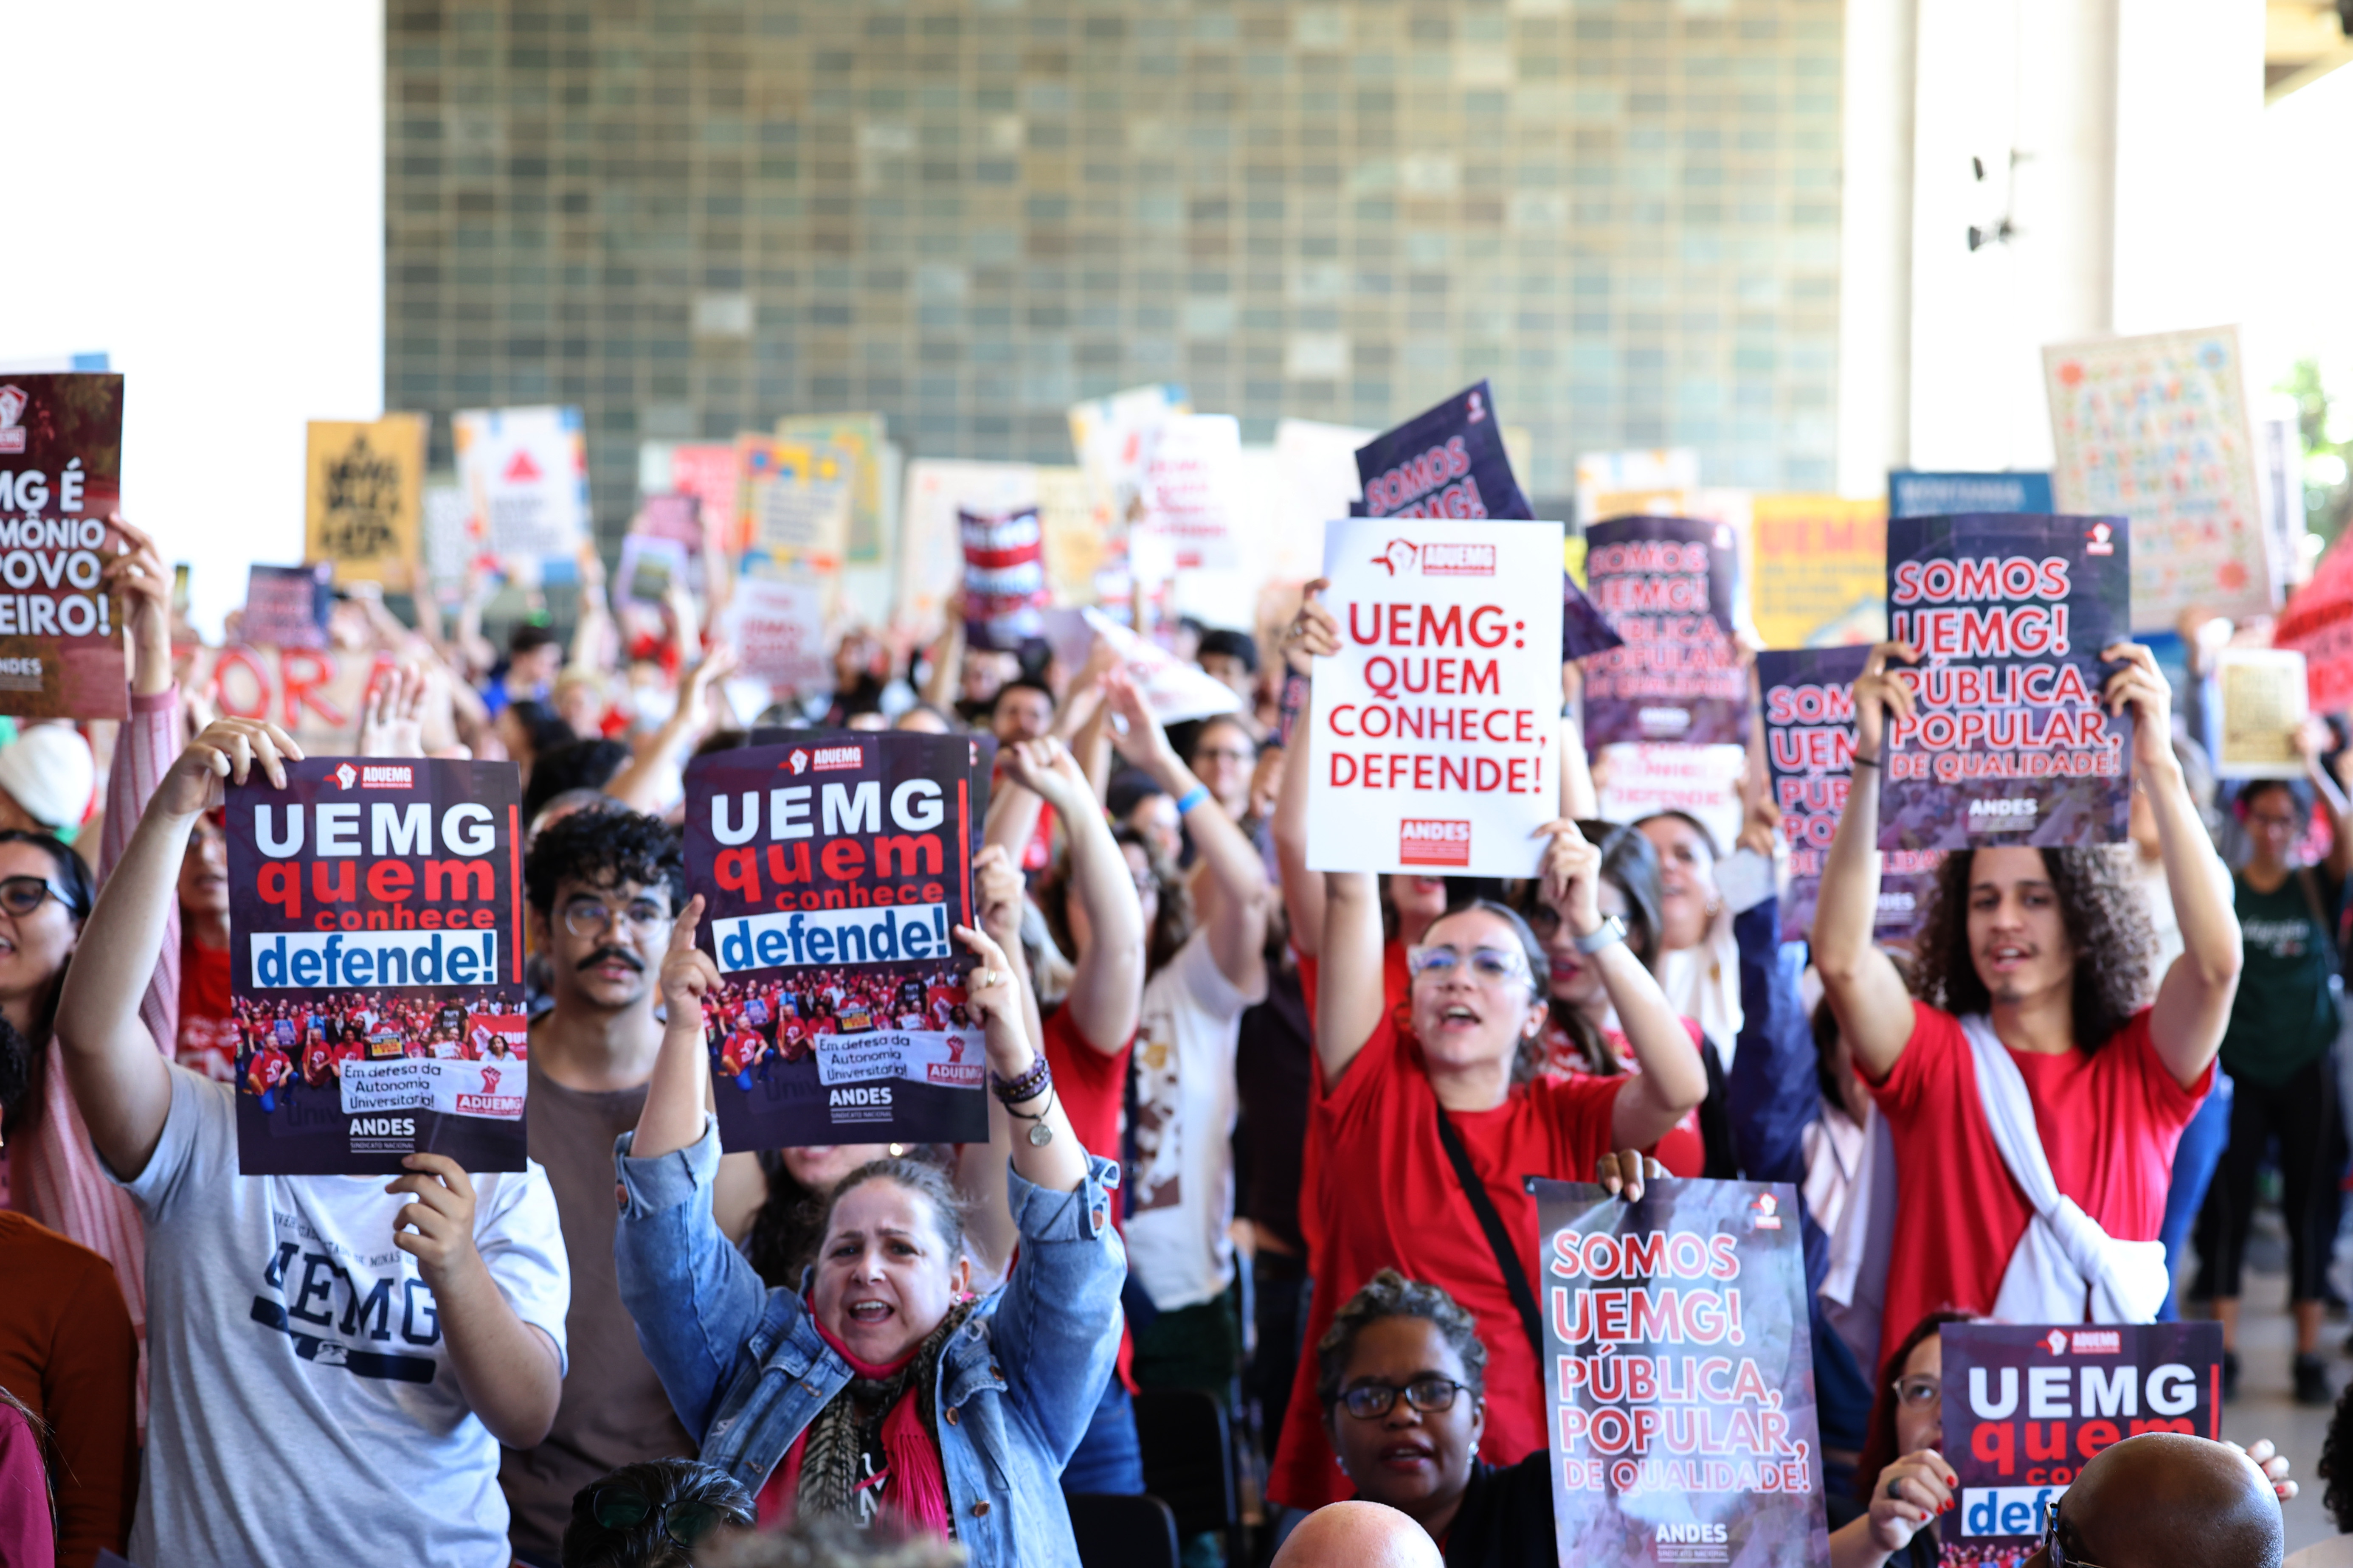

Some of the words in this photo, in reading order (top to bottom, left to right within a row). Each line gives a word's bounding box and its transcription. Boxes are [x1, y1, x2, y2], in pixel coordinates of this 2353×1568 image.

[60, 456, 85, 512] É
[1364, 435, 1470, 517] SOMOS
[0, 550, 102, 590] OVO
[1894, 556, 2070, 604] SOMOS
[1349, 602, 1525, 649] UEMG:
[1893, 604, 2069, 657] UEMG!
[1365, 656, 1500, 700] QUEM
[1894, 657, 2103, 711] PÚBLICA,
[1329, 705, 1546, 748] CONHECE,
[1890, 707, 2123, 751] POPULAR,
[363, 766, 412, 782] ADUEMG
[813, 747, 861, 764] ADUEMG
[1330, 752, 1542, 794] DEFENDE!
[1890, 753, 1930, 780] DE
[1935, 750, 2121, 783] QUALIDADE!
[712, 778, 944, 846] UEMG
[1968, 798, 2038, 816] ANDES
[255, 803, 495, 858] UEMG
[1402, 821, 1469, 840] ANDES
[257, 858, 495, 919] quem
[714, 832, 943, 903] quem
[314, 902, 495, 931] conhece
[776, 880, 943, 911] conhece
[258, 933, 493, 987] defende!
[722, 907, 947, 971] defende!
[820, 1039, 839, 1051] Em
[842, 1037, 887, 1050] defesa
[892, 1034, 910, 1047] da
[831, 1050, 901, 1065] Autonomia
[345, 1065, 365, 1078] Em
[368, 1065, 417, 1078] defesa
[422, 1062, 441, 1076] da
[355, 1077, 430, 1093] Autonomia
[459, 1097, 521, 1111] ADUEMG
[830, 1087, 892, 1106] ANDES
[349, 1118, 415, 1136] ANDES
[1551, 1228, 1741, 1280] SOMOS
[1551, 1286, 1745, 1346] UEMG!
[1557, 1343, 1783, 1410] PÚBLICA,
[1968, 1363, 2198, 1420] UEMG
[1558, 1405, 1810, 1461] POPULAR,
[1564, 1459, 1605, 1492] DE
[1610, 1458, 1811, 1496] QUALIDADE!
[1655, 1523, 1728, 1543] ANDES
